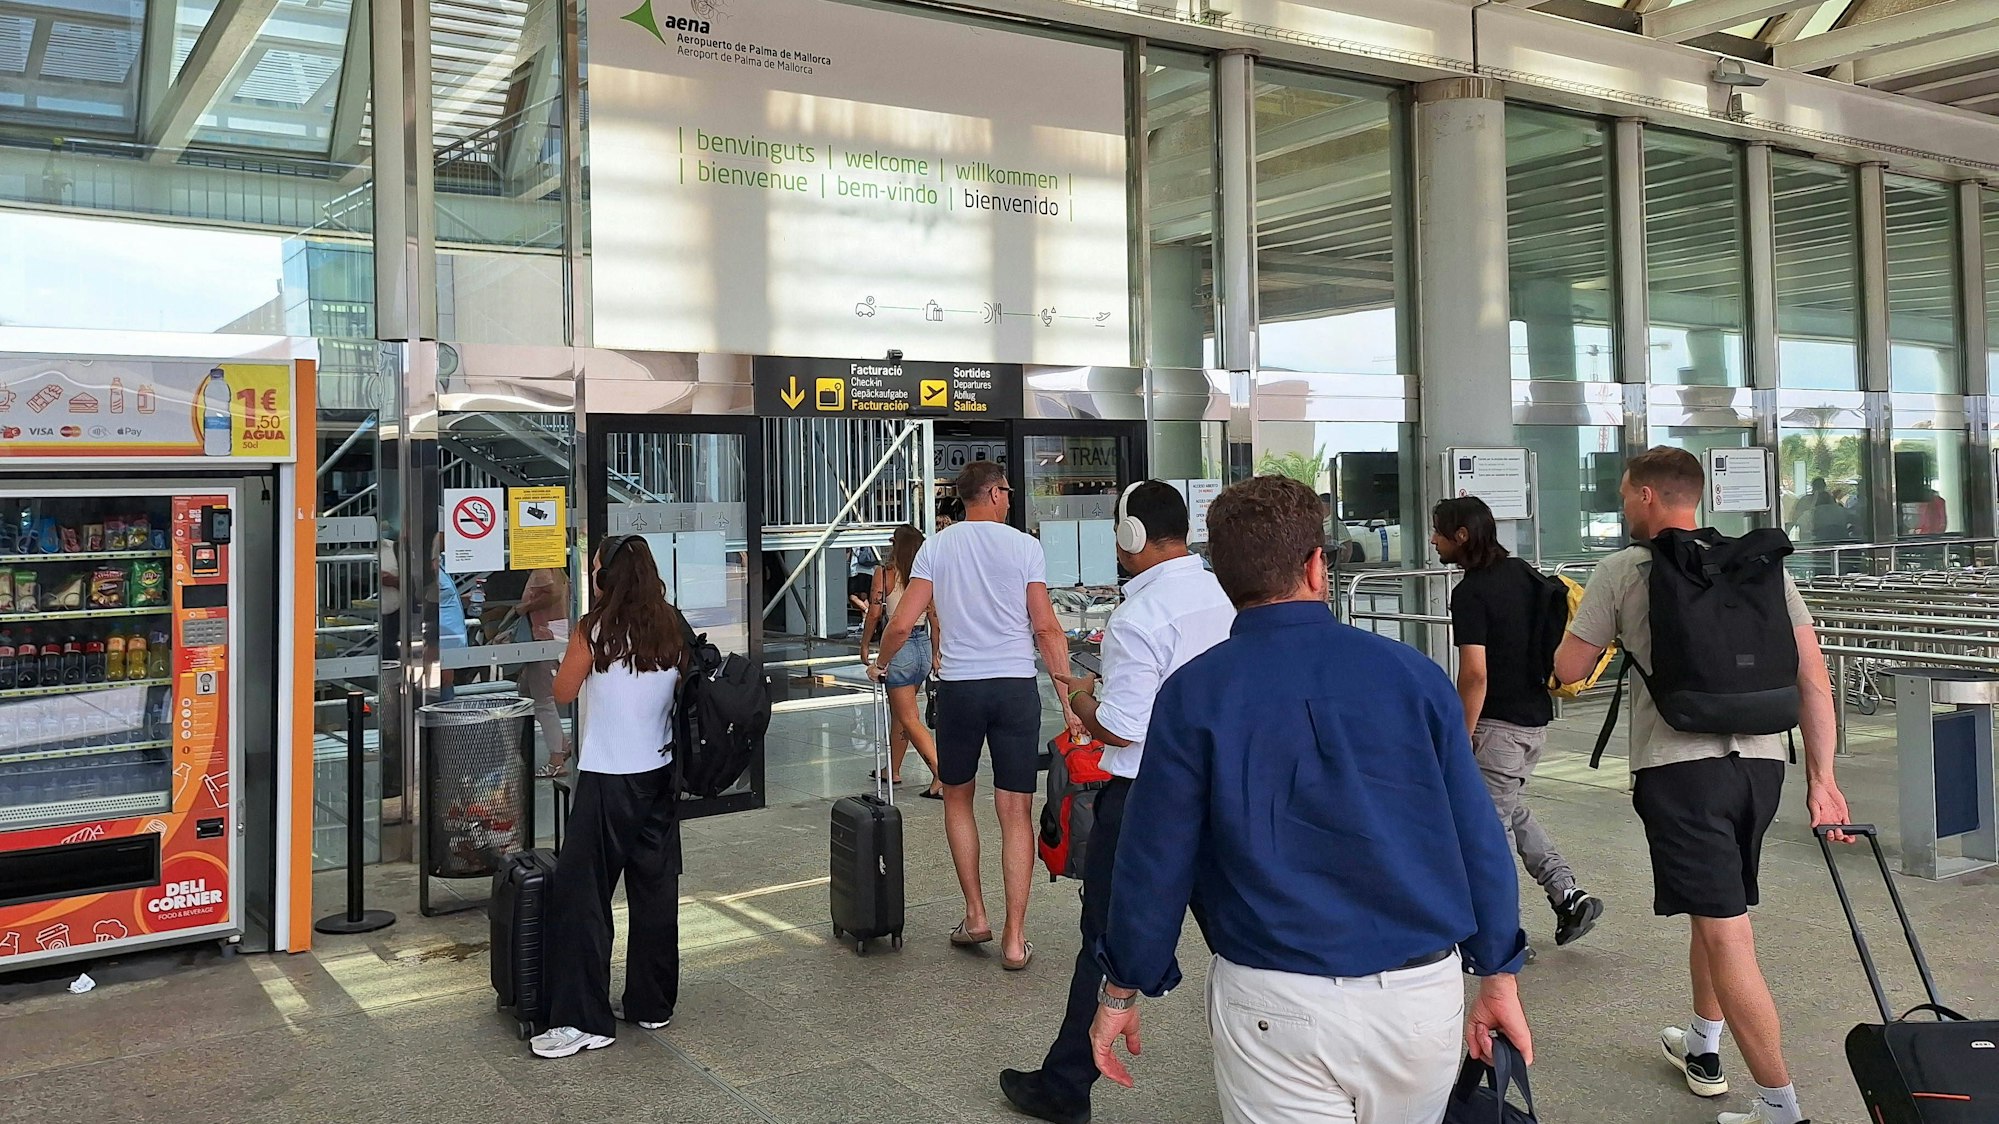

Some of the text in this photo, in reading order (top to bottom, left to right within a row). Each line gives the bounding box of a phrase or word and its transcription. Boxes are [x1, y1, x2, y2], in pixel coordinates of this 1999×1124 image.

[665, 15, 711, 34] aena
[677, 33, 832, 66] Aeropuerto de Palma de Mallorca
[677, 45, 813, 75] Aeroport de Palma de Mallorca
[697, 129, 1059, 190] benvinguts welcome willkommen
[698, 159, 1060, 217] bienvenue bem-vindo bienvenido
[850, 364, 903, 376] Facturació
[953, 367, 991, 379] Sortides
[851, 376, 883, 387] Check-in
[953, 379, 992, 390] Departures
[851, 387, 909, 400] Gepäckaufgabe
[953, 390, 976, 402] Abflug
[851, 399, 909, 411] Facturación
[953, 401, 988, 412] Salidas
[28, 427, 54, 436] VISA
[124, 427, 142, 438] Pay
[242, 430, 286, 440] AGUA
[242, 441, 259, 449] 50cl
[166, 879, 205, 896] DELI
[148, 890, 223, 912] CORNER
[158, 912, 177, 920] FOOD
[183, 907, 214, 917] BEVERAGE
